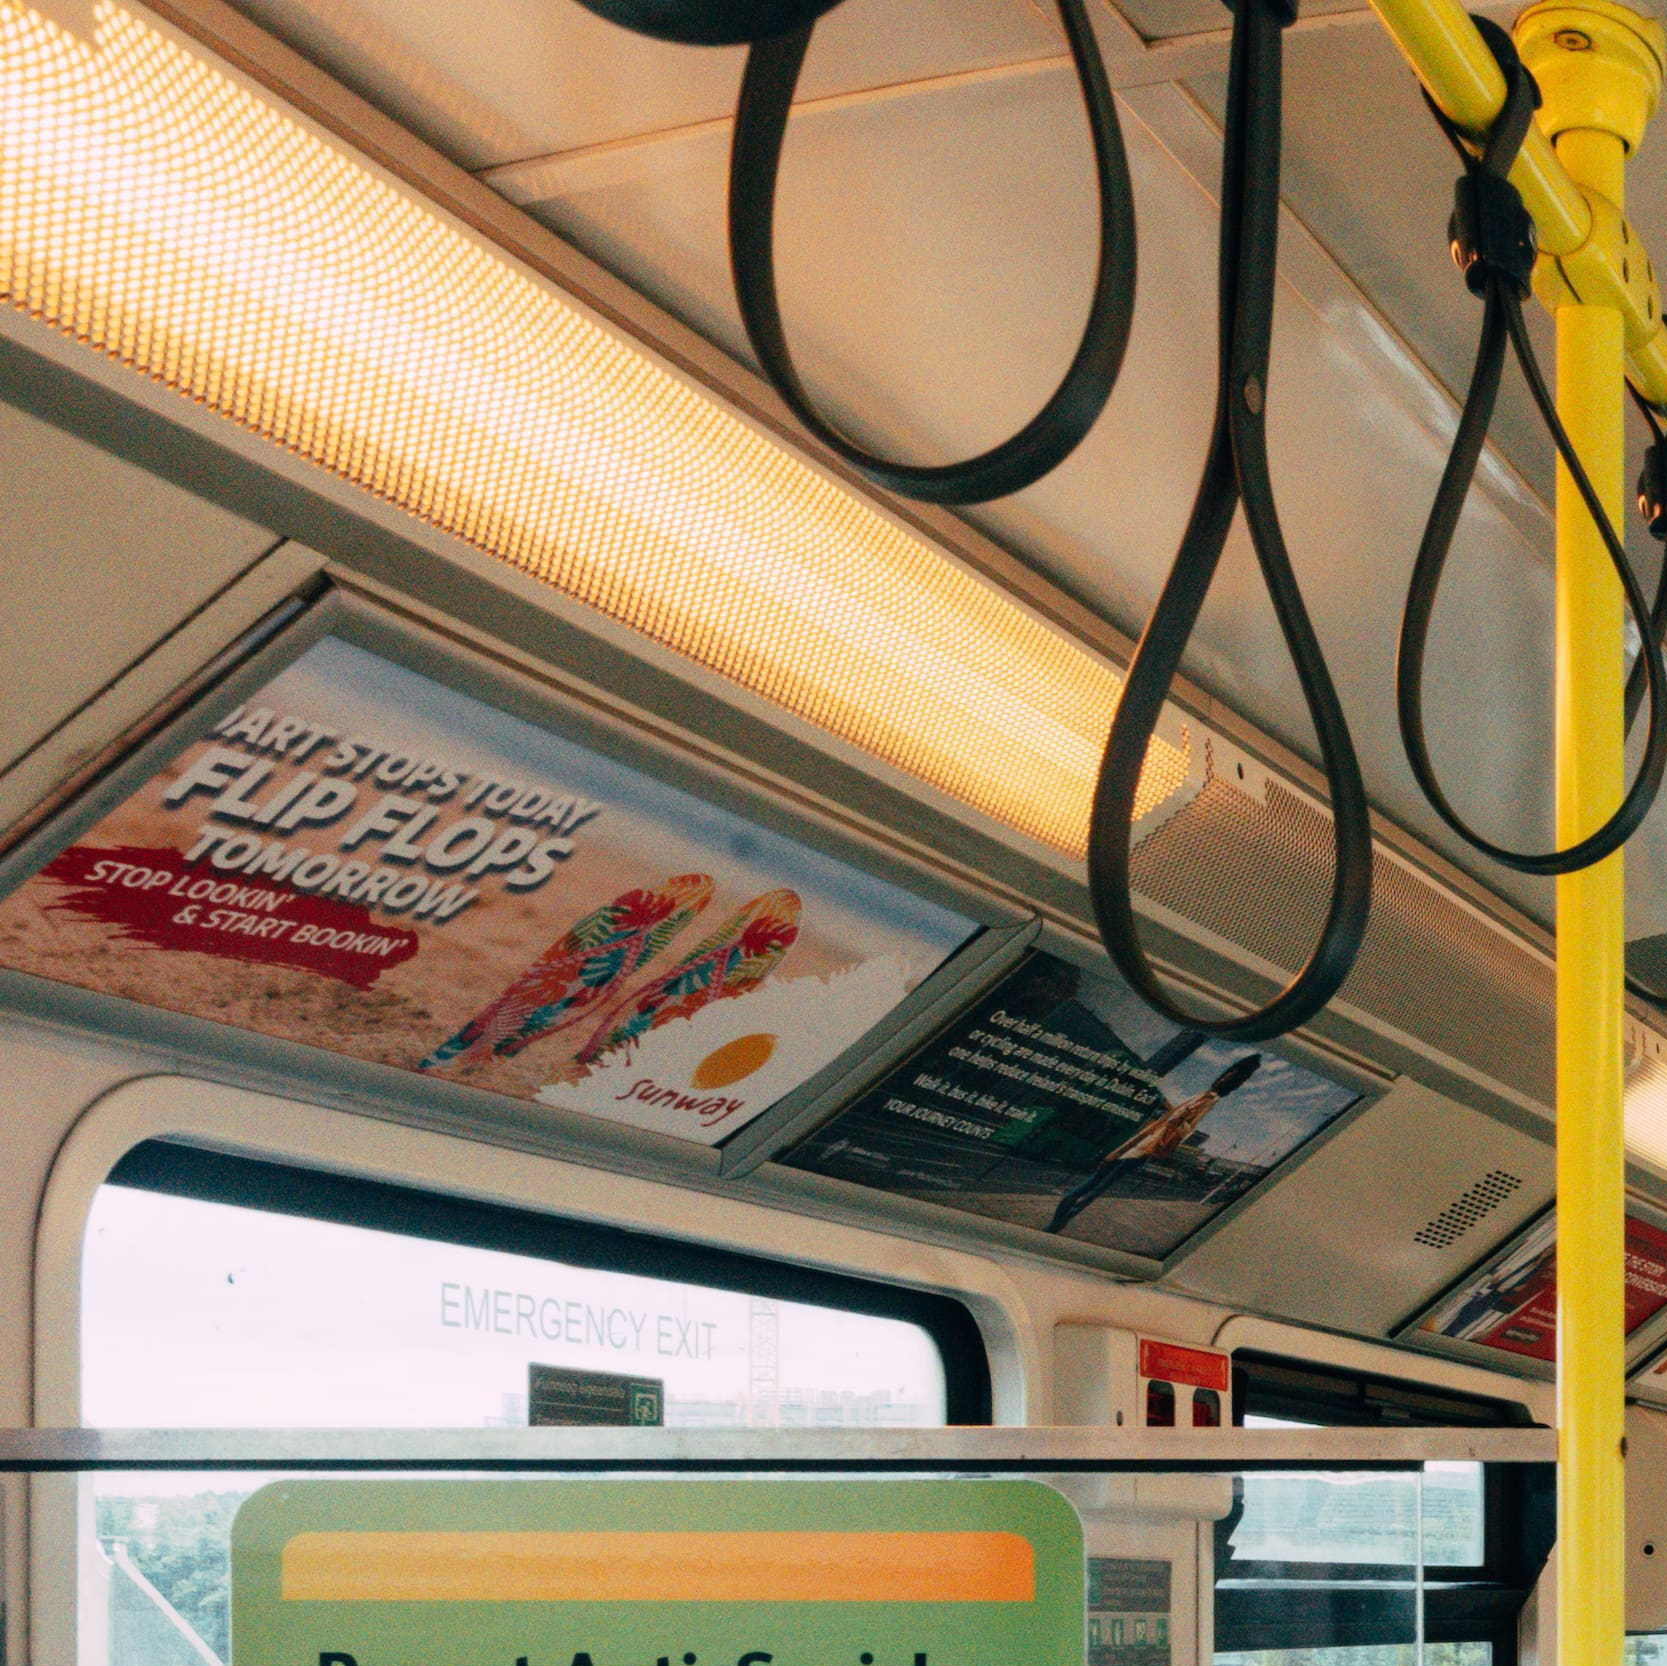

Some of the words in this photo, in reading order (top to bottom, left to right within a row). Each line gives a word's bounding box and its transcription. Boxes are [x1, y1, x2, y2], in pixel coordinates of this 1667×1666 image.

[165, 746, 360, 830] FLIP
[344, 797, 575, 886] FLOPS
[325, 739, 462, 796] STOPS
[467, 774, 600, 831] TODAY
[85, 860, 173, 888] STOP
[169, 874, 296, 912] LOOKIN'
[185, 827, 480, 917] TOMORROW
[172, 905, 196, 925] &
[203, 910, 300, 943] START
[291, 924, 409, 956] BOOKIN'
[882, 1097, 916, 1114] YOUR
[952, 1119, 995, 1139] COUNTS
[442, 1282, 647, 1351] EMERGENCY
[657, 1315, 716, 1360] EXIT
